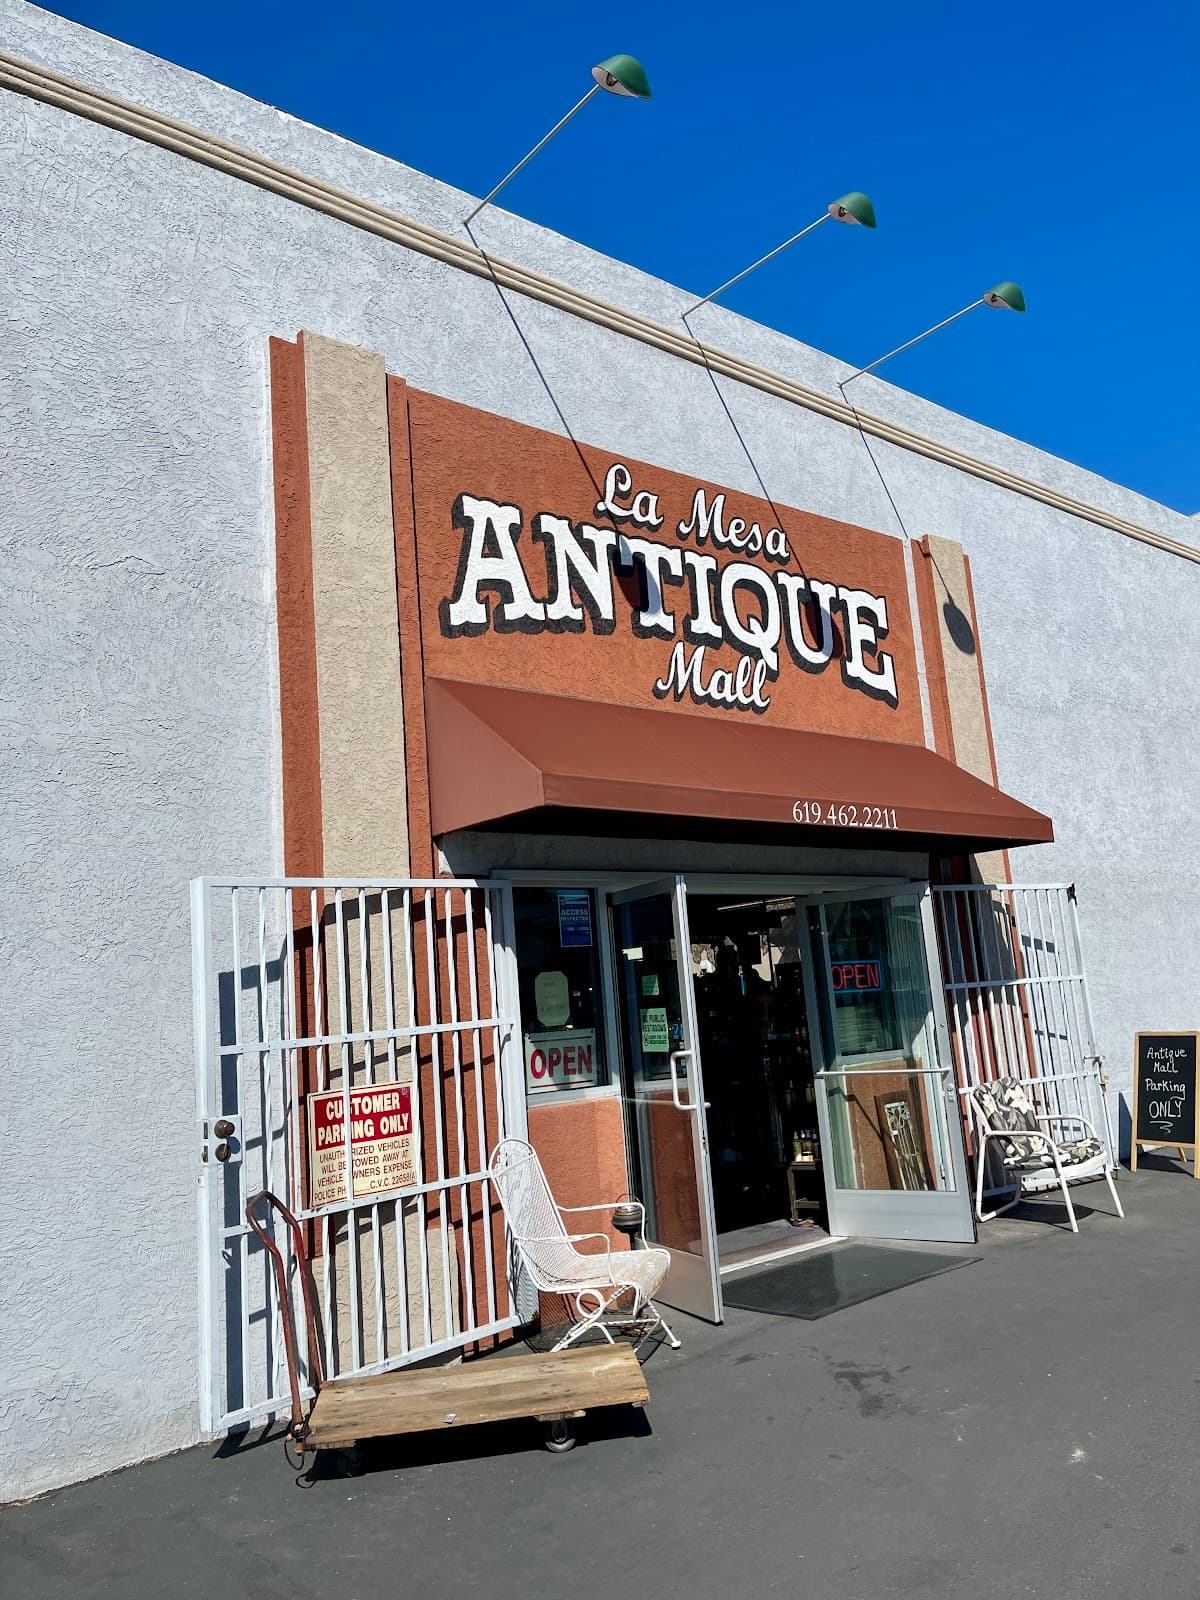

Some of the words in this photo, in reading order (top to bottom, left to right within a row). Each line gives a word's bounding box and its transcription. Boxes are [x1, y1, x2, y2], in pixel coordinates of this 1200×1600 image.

[597, 463, 664, 527] La
[678, 488, 790, 565] Mesa
[440, 493, 899, 708] ANTIQUE
[653, 642, 771, 714] Mall
[792, 800, 899, 830] 619.462.2211
[831, 963, 880, 990] OPEN
[530, 1045, 593, 1080] OPEN
[1147, 1047, 1187, 1063] Antique
[1153, 1062, 1179, 1074] Mall
[1145, 1078, 1185, 1100] Parking
[326, 1092, 400, 1120] CUTOMER
[1148, 1100, 1182, 1119] ONLY
[379, 1113, 409, 1135] ONLY
[320, 1145, 375, 1164] UNAUTHRIZED
[378, 1138, 410, 1152] VEHICLES
[322, 1162, 336, 1175] WILL
[339, 1161, 347, 1171] BE
[352, 1155, 380, 1168] OWED
[383, 1151, 400, 1163] AWAY
[402, 1149, 409, 1160] AT
[318, 1173, 344, 1188] VEHICLE
[352, 1166, 381, 1180] WNERS
[314, 1188, 336, 1202] POLICE
